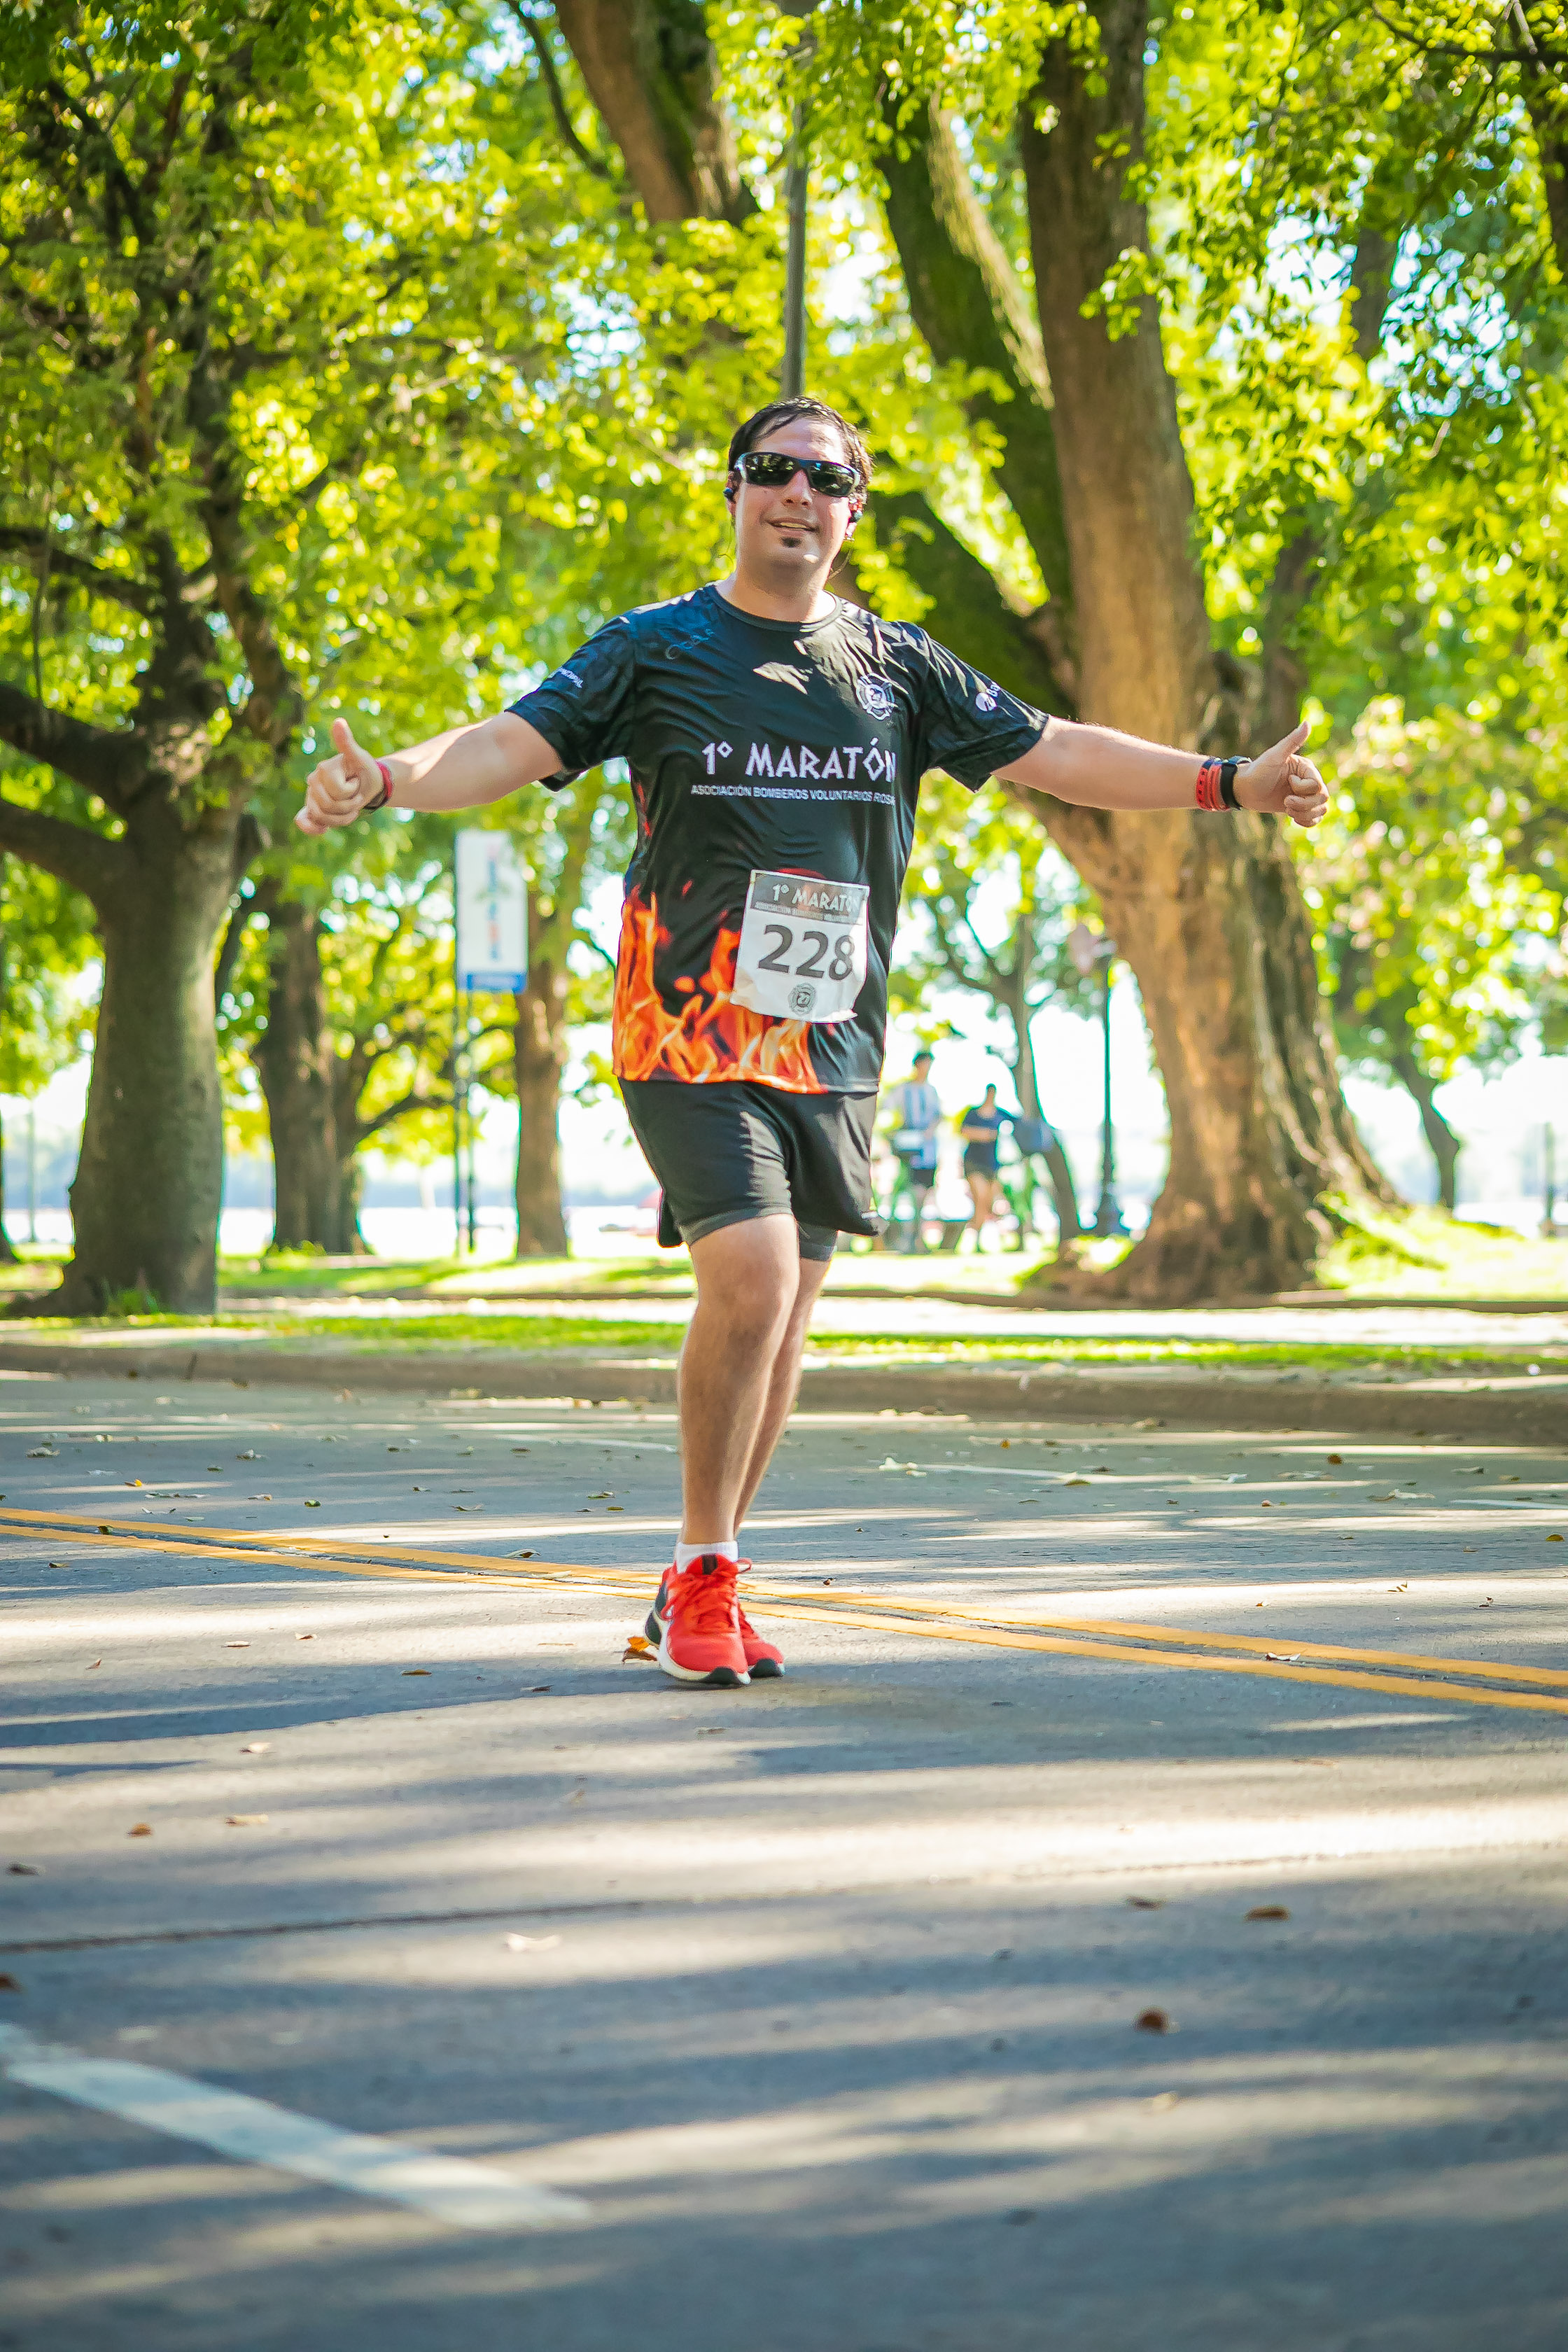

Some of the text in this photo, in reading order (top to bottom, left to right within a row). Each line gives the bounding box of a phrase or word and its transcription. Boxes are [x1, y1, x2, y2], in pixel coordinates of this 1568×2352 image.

[745, 737, 897, 783] MARATÓN
[752, 787, 808, 800] BOMBEROS
[809, 789, 873, 802] VOLUNTARIOS
[758, 924, 855, 981] 228
